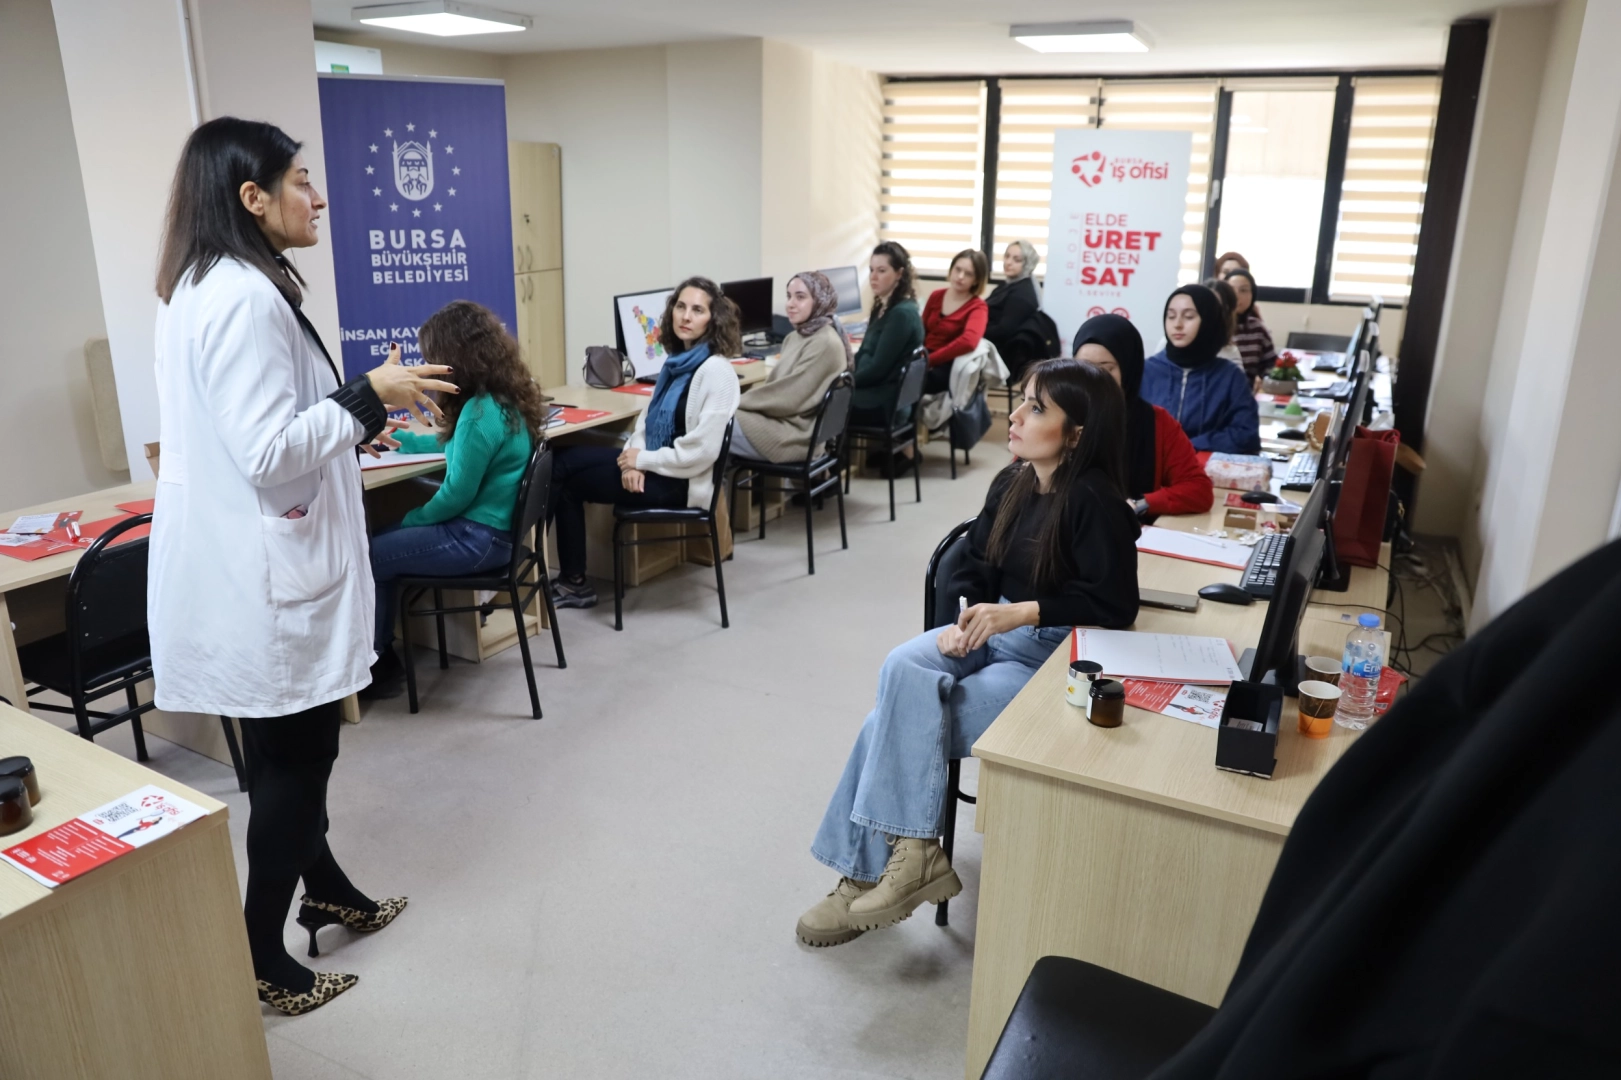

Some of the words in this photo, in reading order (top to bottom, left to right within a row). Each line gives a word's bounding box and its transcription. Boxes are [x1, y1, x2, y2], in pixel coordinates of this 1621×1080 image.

[1110, 162, 1126, 182] iş
[1129, 161, 1169, 180] ofisi
[1085, 212, 1128, 227] ELDE
[369, 228, 467, 250] BURSA
[1084, 229, 1162, 251] ÜRET
[371, 248, 467, 267] BÜYÜKŞEHİR
[1082, 250, 1140, 266] EVDEN
[373, 265, 469, 284] BELEDİYESİ
[1080, 266, 1135, 287] SAT
[340, 327, 388, 342] İNSAN
[370, 340, 421, 356] EĞTİM
